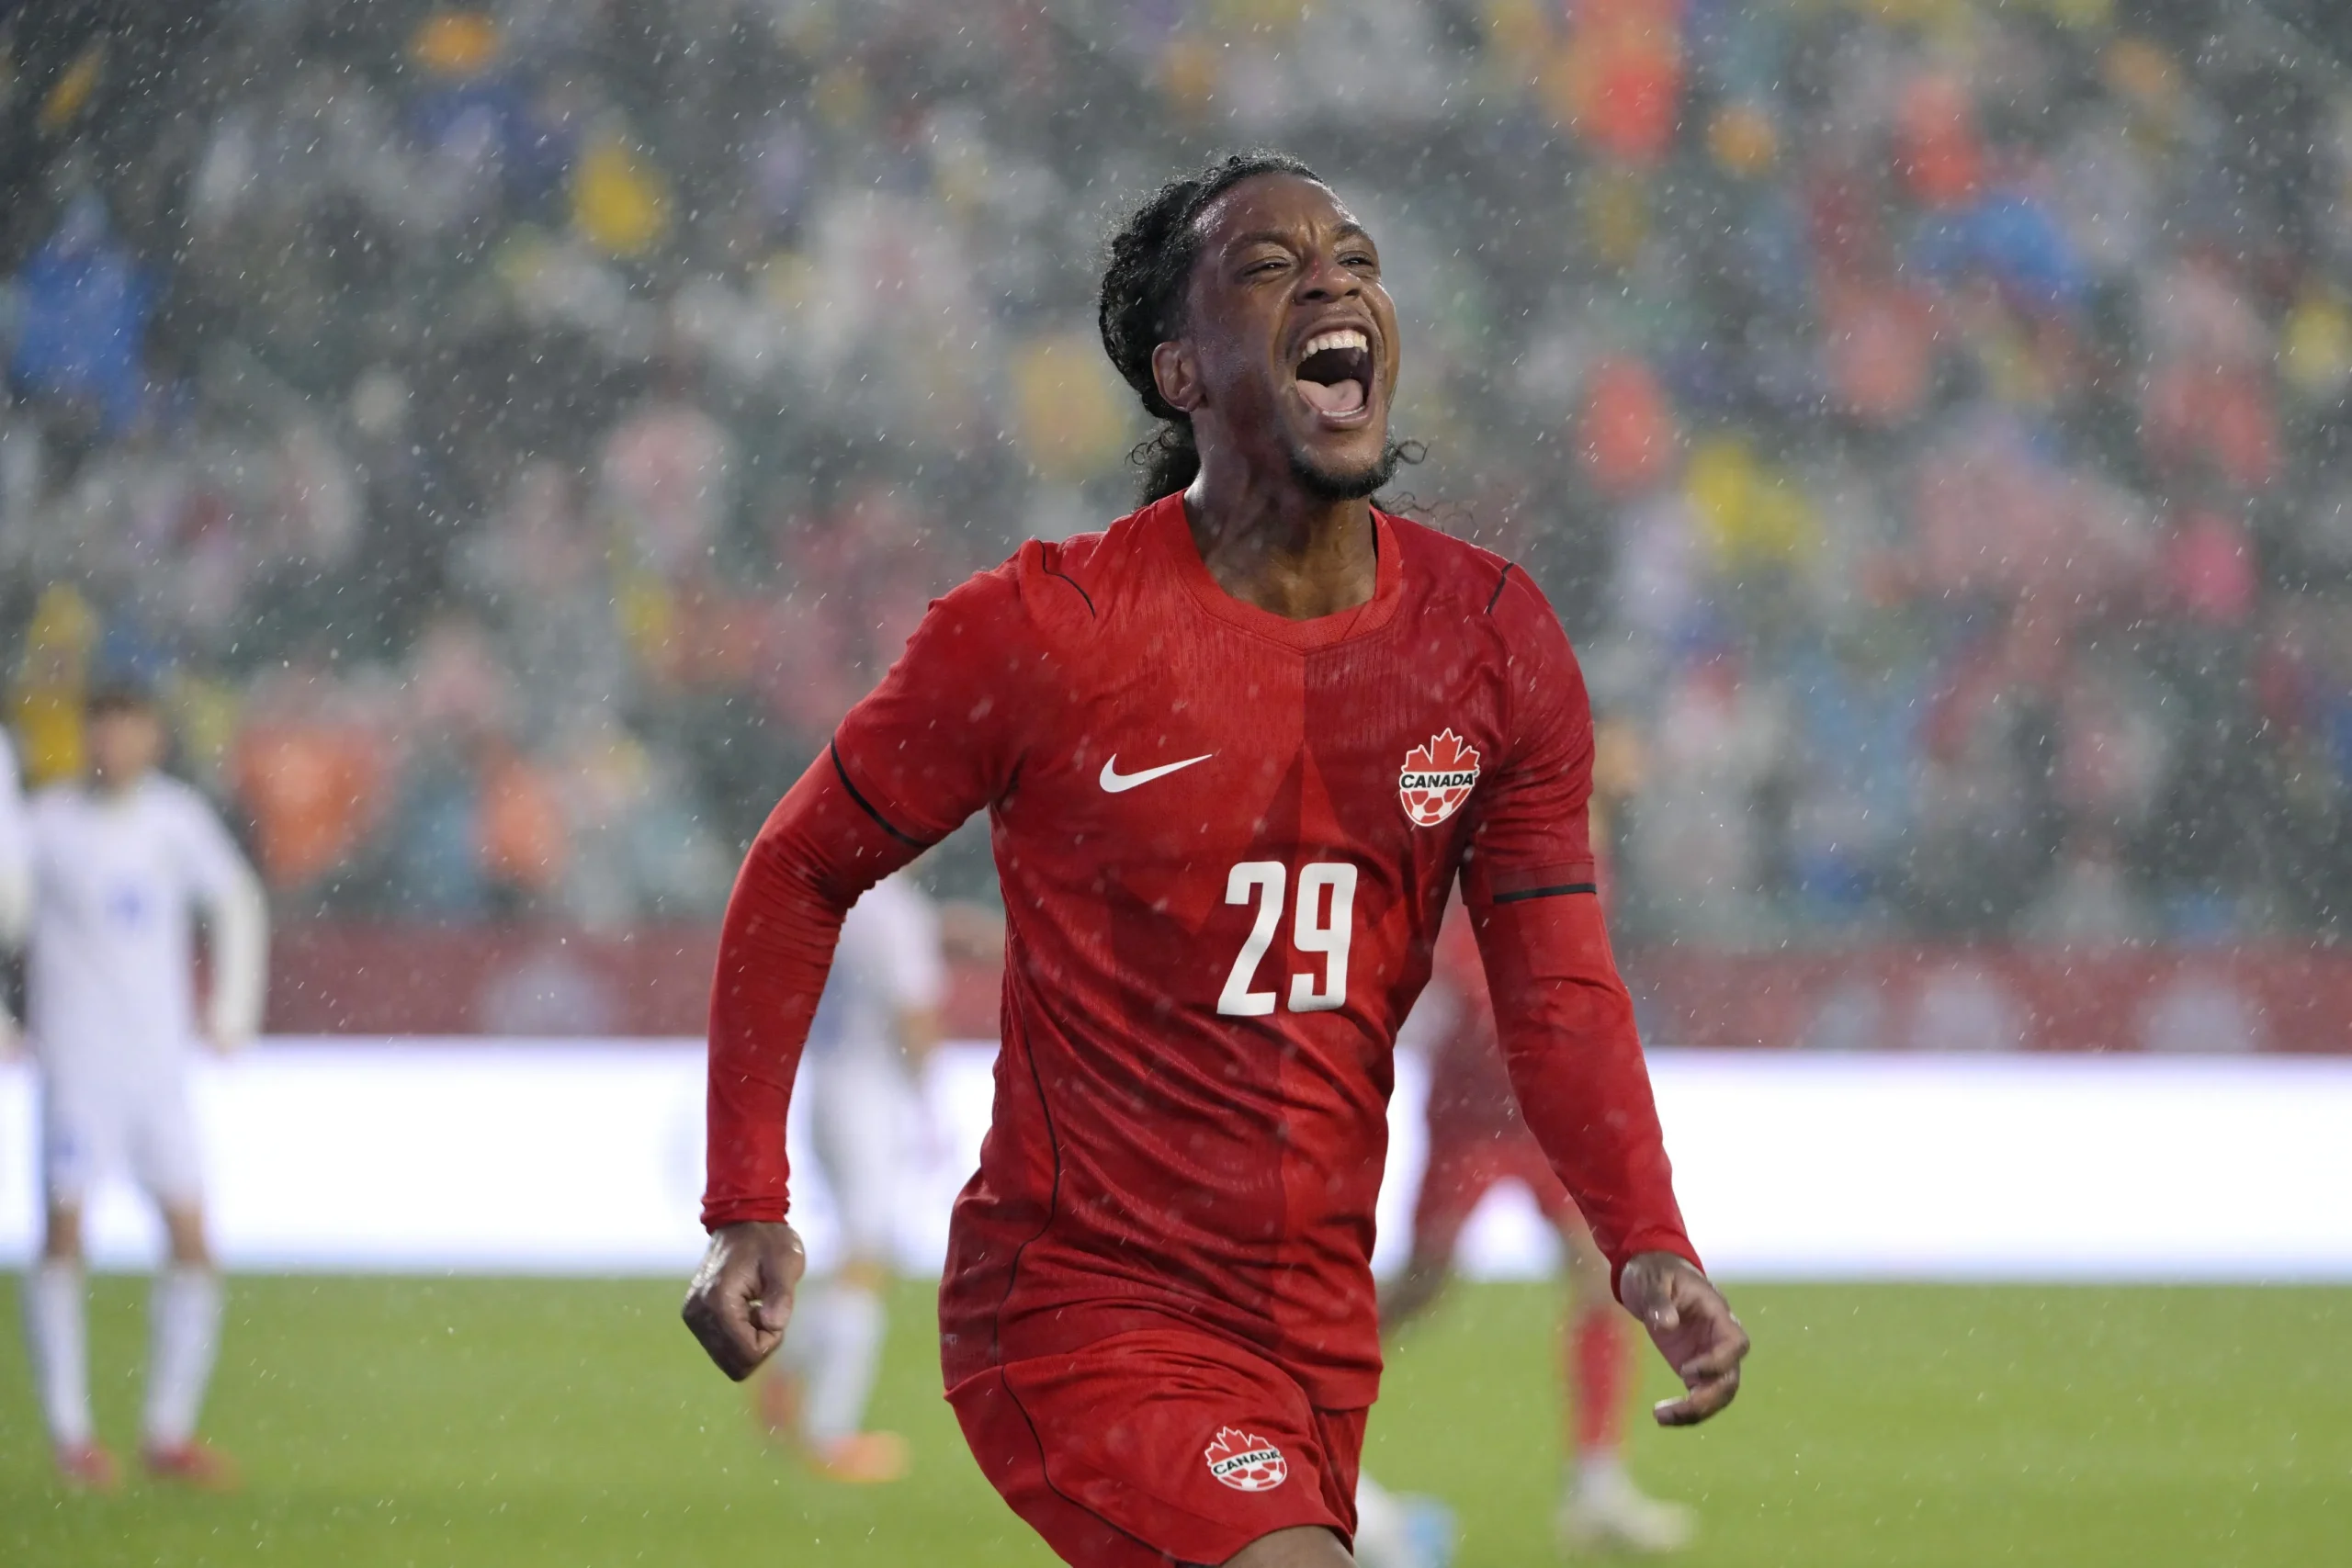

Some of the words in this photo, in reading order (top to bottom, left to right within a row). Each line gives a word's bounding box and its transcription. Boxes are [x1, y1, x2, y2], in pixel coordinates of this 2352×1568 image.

[1401, 773, 1474, 788] CANADA
[1216, 861, 1358, 1016] 29
[1214, 1451, 1280, 1474] CANADA
